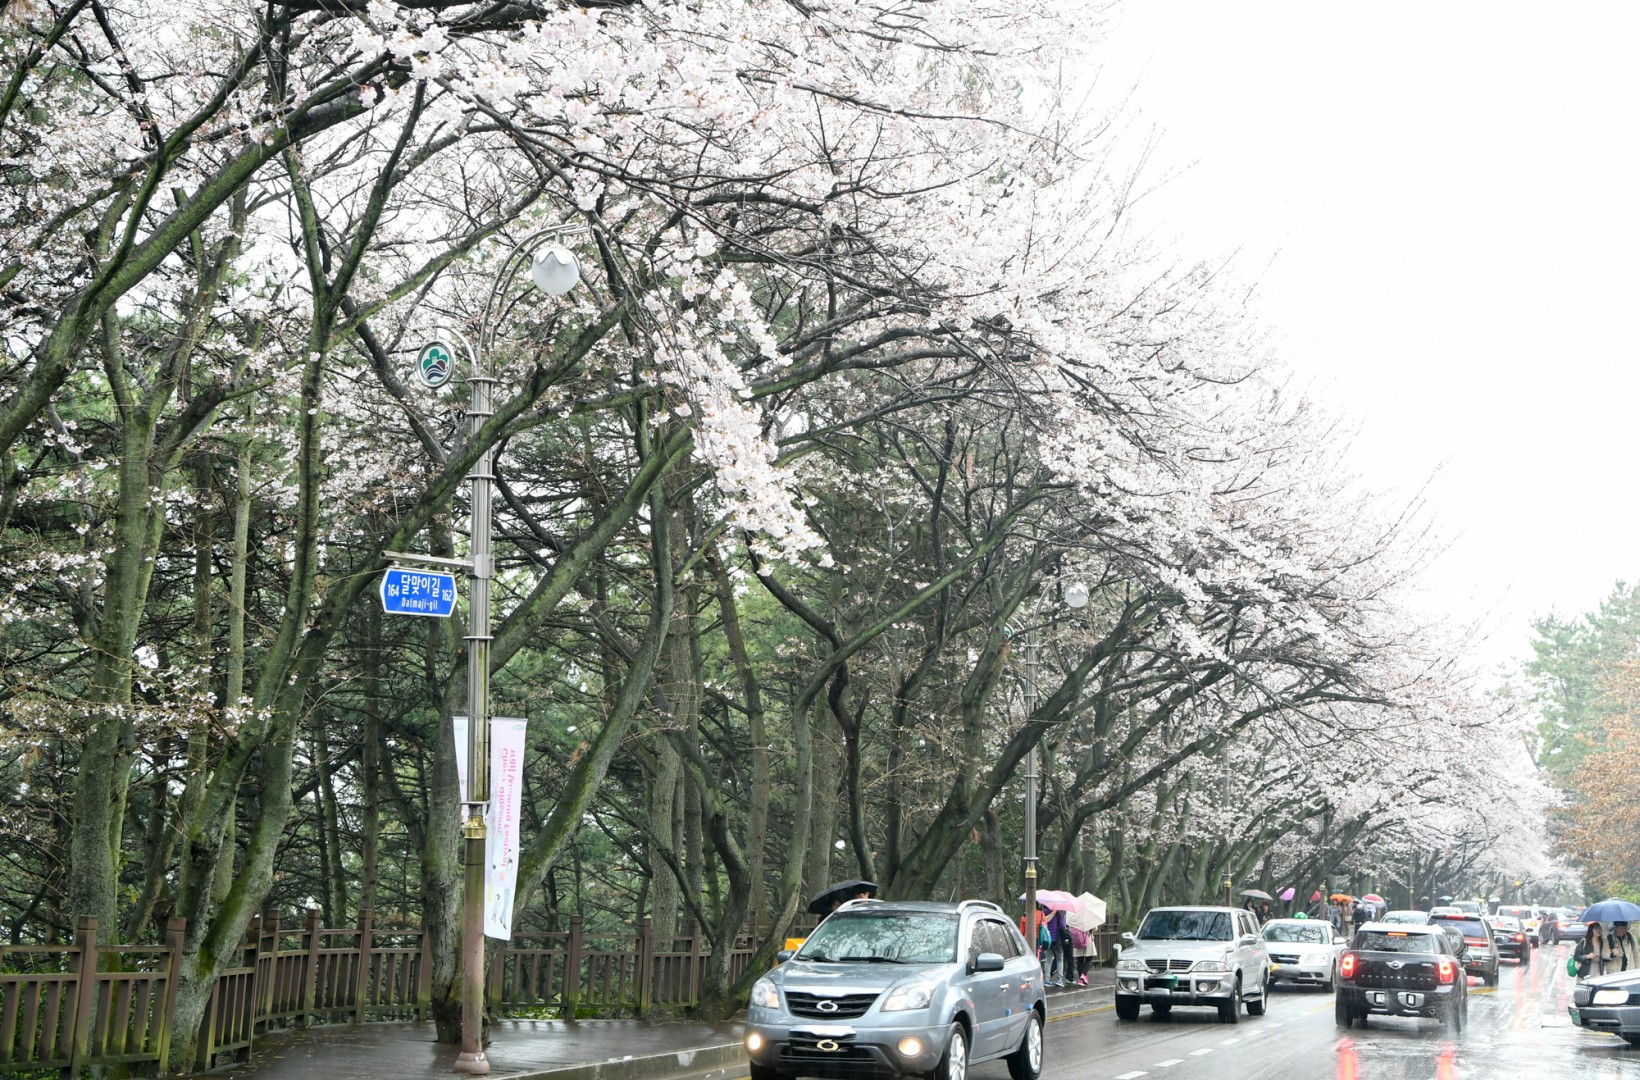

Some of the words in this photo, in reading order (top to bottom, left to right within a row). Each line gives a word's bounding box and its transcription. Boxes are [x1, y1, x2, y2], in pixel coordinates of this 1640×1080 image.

[388, 584, 399, 597] 164
[401, 574, 440, 597] 달맞이길
[442, 590, 453, 602] 162
[402, 597, 438, 612] Dalmaji-gil
